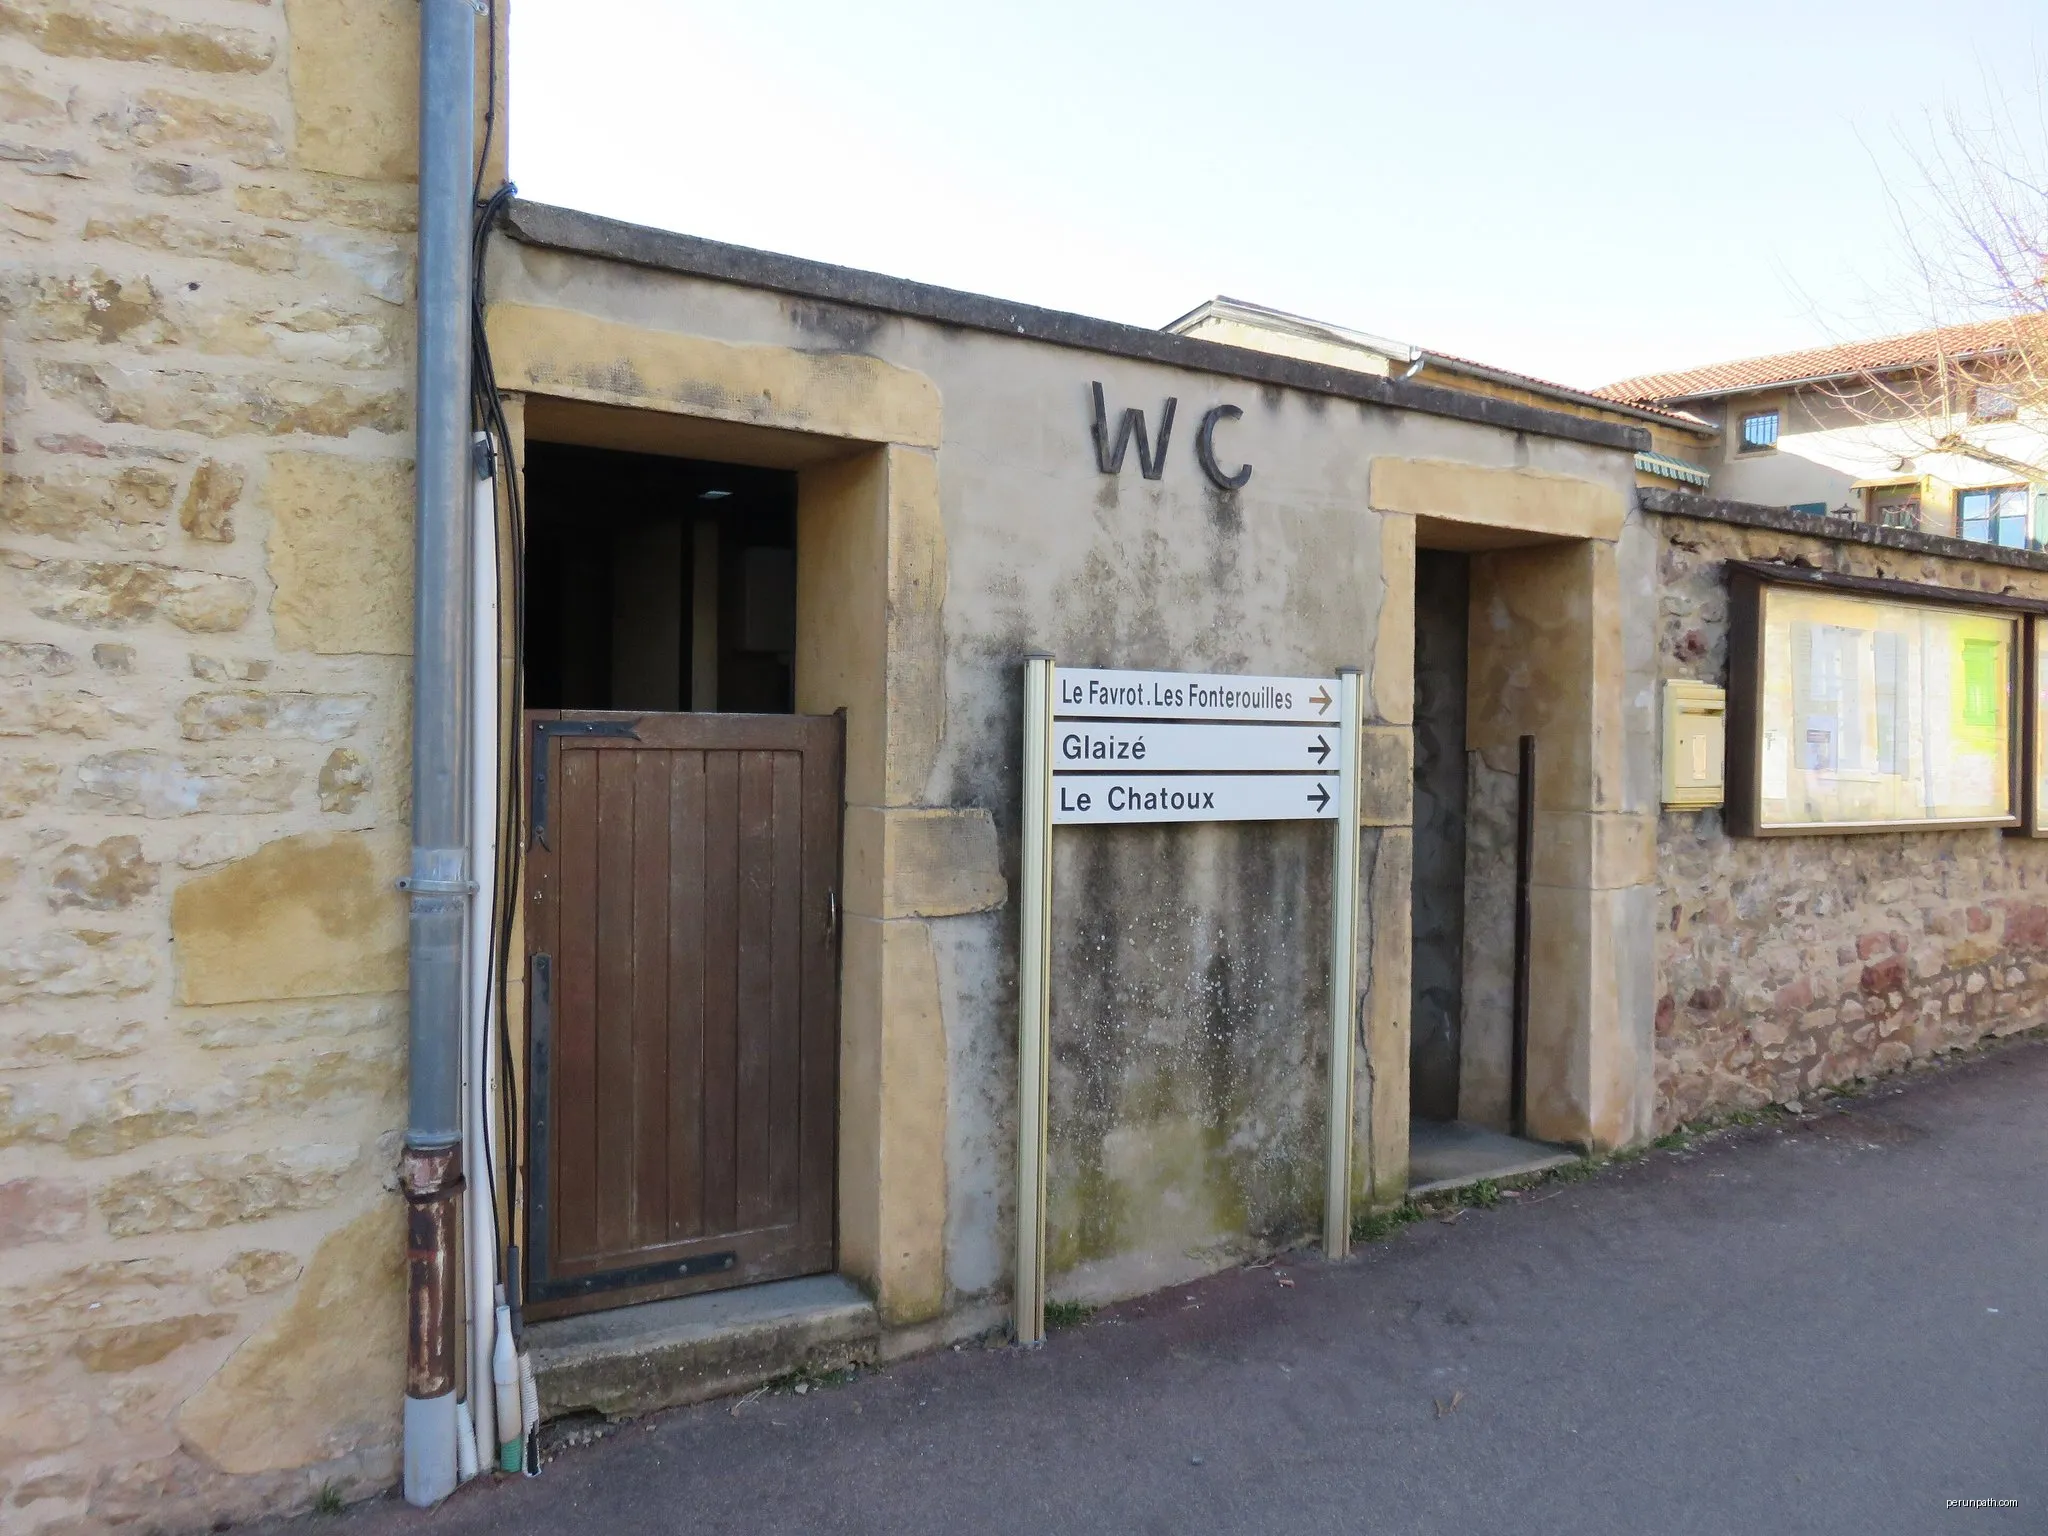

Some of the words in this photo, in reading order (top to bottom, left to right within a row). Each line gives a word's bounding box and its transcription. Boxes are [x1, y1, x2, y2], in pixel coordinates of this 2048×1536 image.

[1092, 380, 1252, 490] WC
[1062, 679, 1082, 705] Le
[1190, 683, 1293, 710] Fonterouilles
[1062, 734, 1146, 760] Glaizé
[1061, 787, 1091, 812] Le
[1107, 786, 1215, 811] Chatoux
